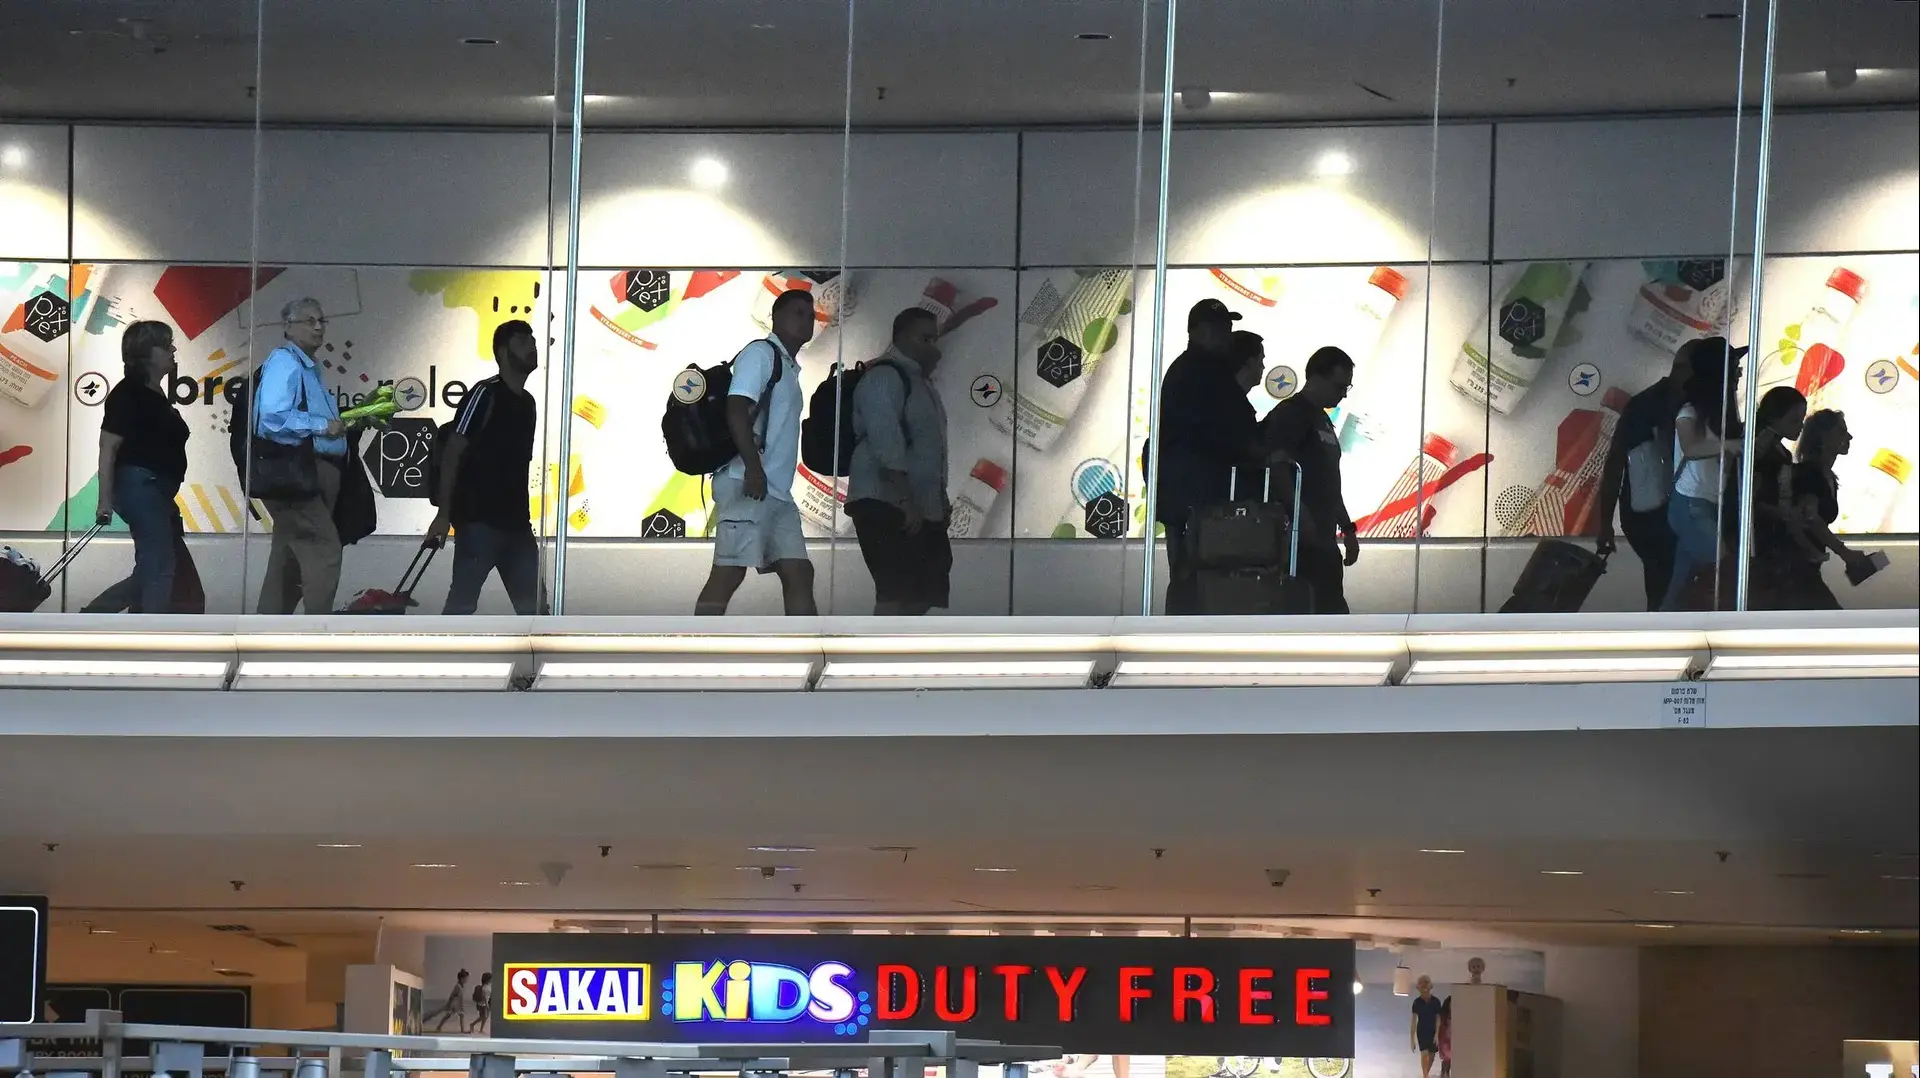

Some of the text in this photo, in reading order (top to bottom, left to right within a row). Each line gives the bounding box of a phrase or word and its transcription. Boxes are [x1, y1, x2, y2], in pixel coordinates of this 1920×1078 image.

[511, 969, 644, 1015] SAKAL
[877, 964, 1087, 1023] DUTY
[1118, 966, 1332, 1026] FREE
